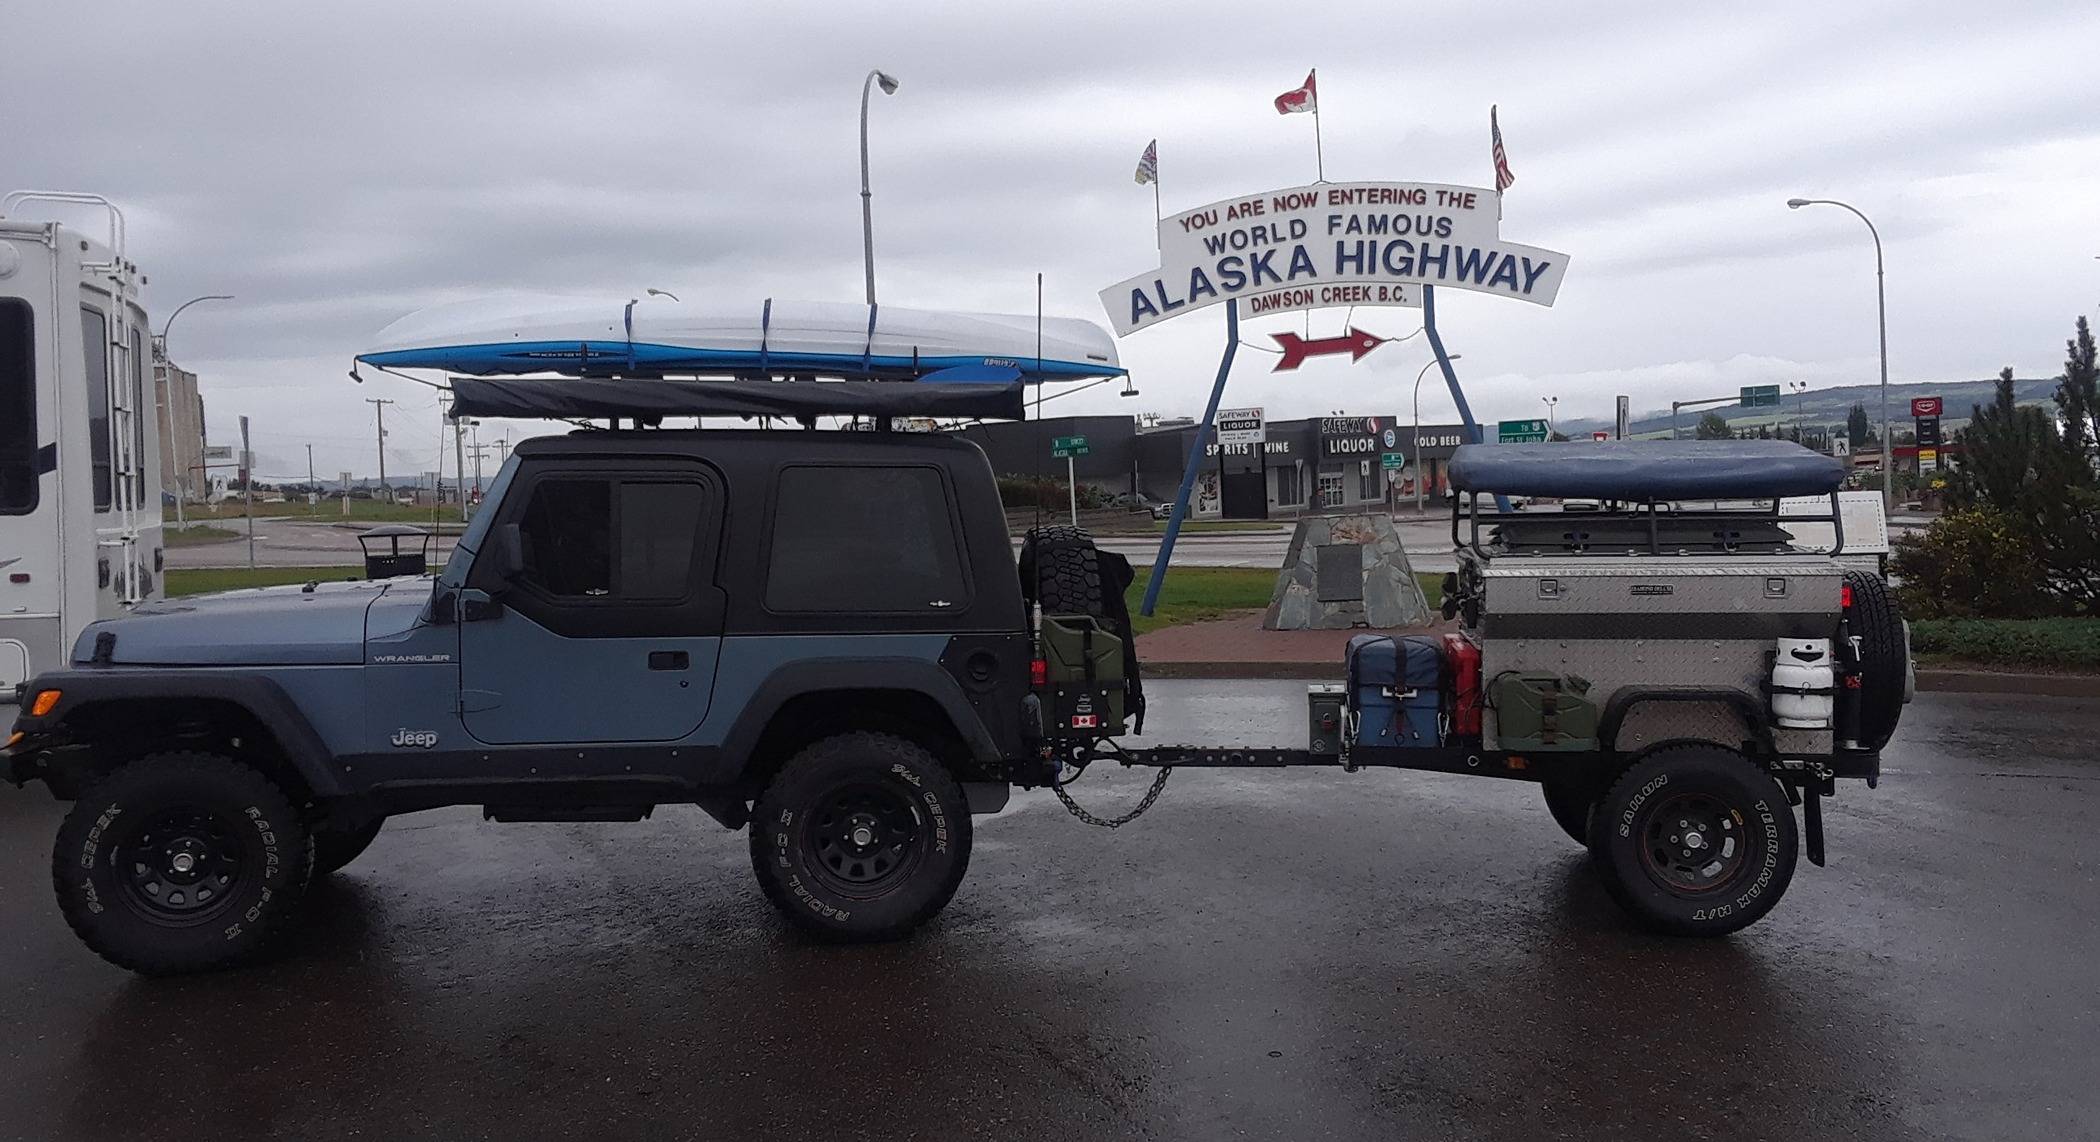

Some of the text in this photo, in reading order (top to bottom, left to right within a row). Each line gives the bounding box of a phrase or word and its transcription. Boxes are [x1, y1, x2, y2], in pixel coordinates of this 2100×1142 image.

[1179, 188, 1477, 233] YOU ARE NOW ENTERING THE
[1203, 213, 1453, 256] WORLD FAMOUS
[1131, 239, 1551, 325] ALASKA HIGHWAY
[1251, 285, 1407, 313] DAWSON CREEK B.C.
[1218, 411, 1251, 419] SAFEWAY
[1223, 421, 1257, 430] LIQUOR
[1321, 417, 1364, 434] SAFEWAY
[1206, 443, 1248, 457] SPRITS
[1329, 438, 1375, 454] LIQUOR
[1439, 435, 1461, 446] BEER
[373, 654, 450, 662] WRANGLER
[390, 727, 438, 749] Jeep
[1619, 774, 1669, 838] SAILUN
[923, 791, 948, 855] CEPEK
[245, 806, 279, 878] RADIAL
[1692, 800, 1779, 920] TERRAMAX H/T
[788, 874, 850, 922] RADIAL
